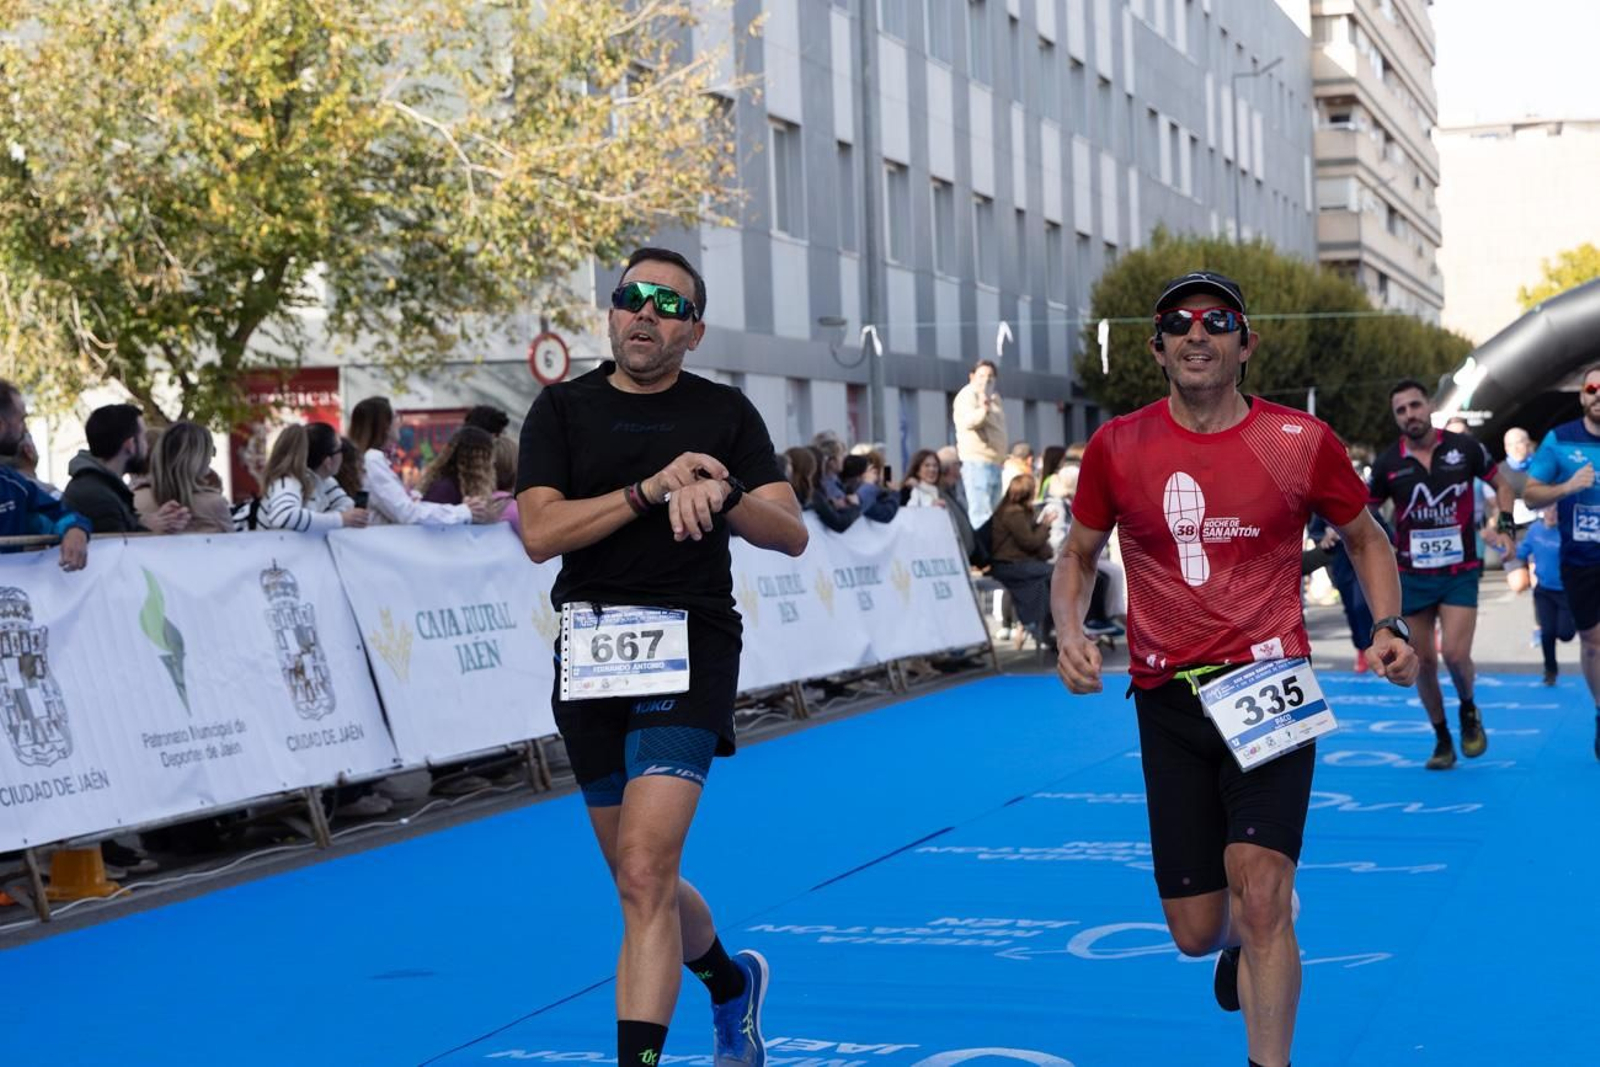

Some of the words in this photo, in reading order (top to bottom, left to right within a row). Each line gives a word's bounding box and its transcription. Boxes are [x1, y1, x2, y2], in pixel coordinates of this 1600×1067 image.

[1177, 525, 1194, 536] 38
[1204, 520, 1229, 528] NOCHE
[1229, 519, 1240, 527] DE
[1420, 539, 1452, 554] 952
[415, 608, 463, 640] CAJA
[460, 602, 517, 635] RURAL
[591, 629, 664, 663] 667
[454, 636, 503, 675] JAÉN
[632, 661, 665, 671] ANTONIO
[1235, 675, 1304, 726] 335
[1274, 713, 1293, 724] PACO
[286, 731, 323, 752] CIUDAD
[321, 728, 338, 746] DE
[339, 721, 365, 744] JAÉN
[0, 781, 54, 808] CIUDAD
[53, 776, 77, 797] DE
[77, 768, 111, 793] JAÉN
[926, 917, 1080, 929] JAÉN
[745, 924, 1044, 937] MARATÓN
[818, 936, 1013, 947] MEDIA
